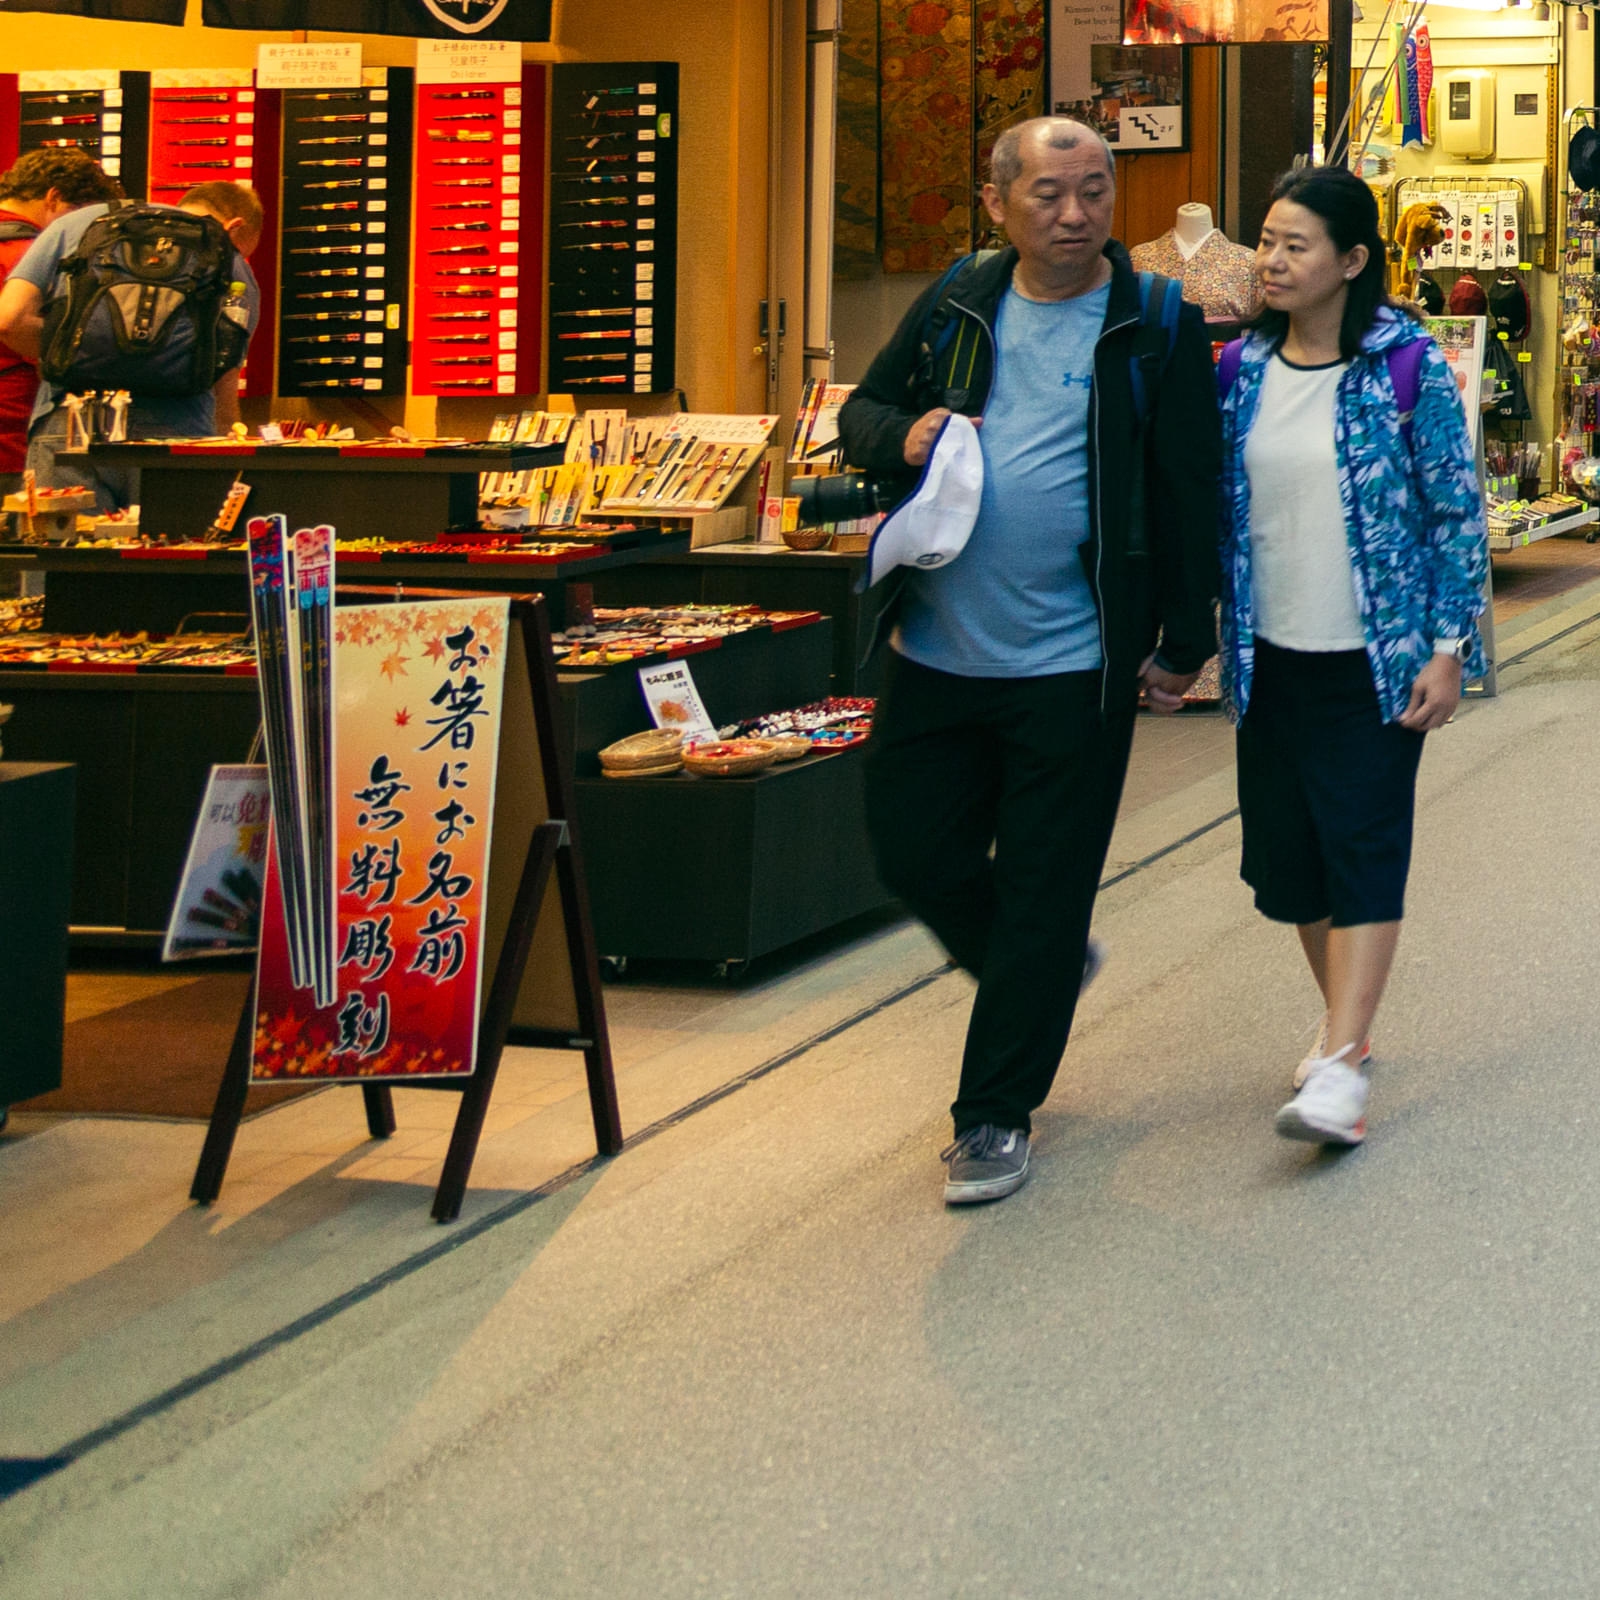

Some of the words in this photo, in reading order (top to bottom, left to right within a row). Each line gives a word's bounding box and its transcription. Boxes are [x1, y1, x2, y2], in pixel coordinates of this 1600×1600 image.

[331, 754, 412, 1060] 無料彫刻
[403, 625, 491, 985] お箸にお名前
